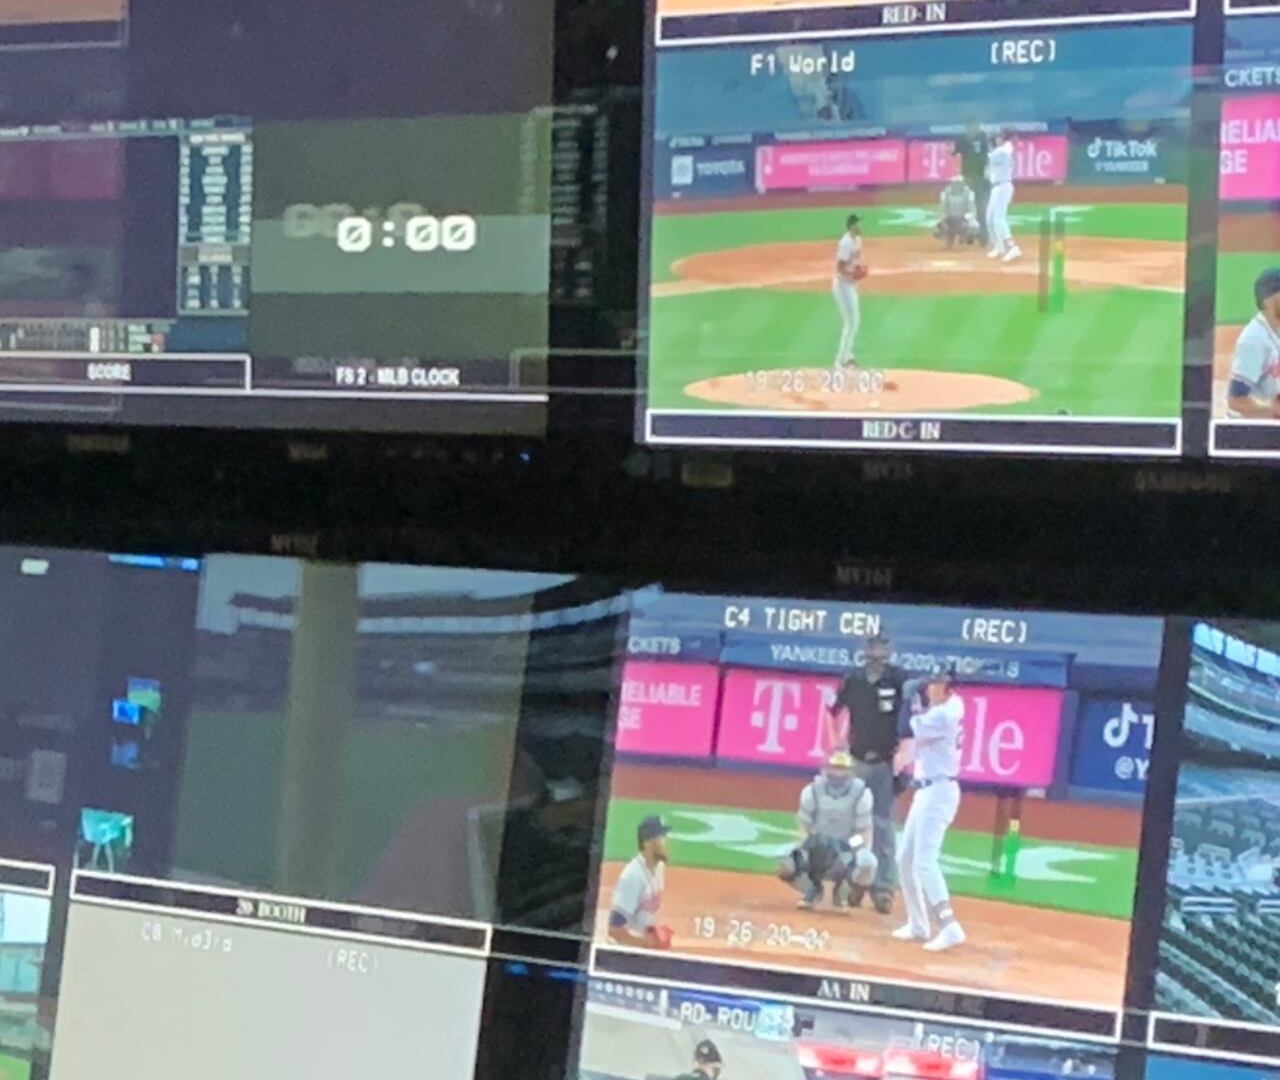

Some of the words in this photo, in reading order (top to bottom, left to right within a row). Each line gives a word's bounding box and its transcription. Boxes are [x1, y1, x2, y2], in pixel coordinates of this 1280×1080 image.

[751, 54, 776, 75] F1
[790, 50, 855, 73] World
[337, 216, 477, 252] 0:00
[725, 606, 751, 628] C4
[765, 607, 827, 632] TIGHT
[840, 612, 880, 636] CEN
